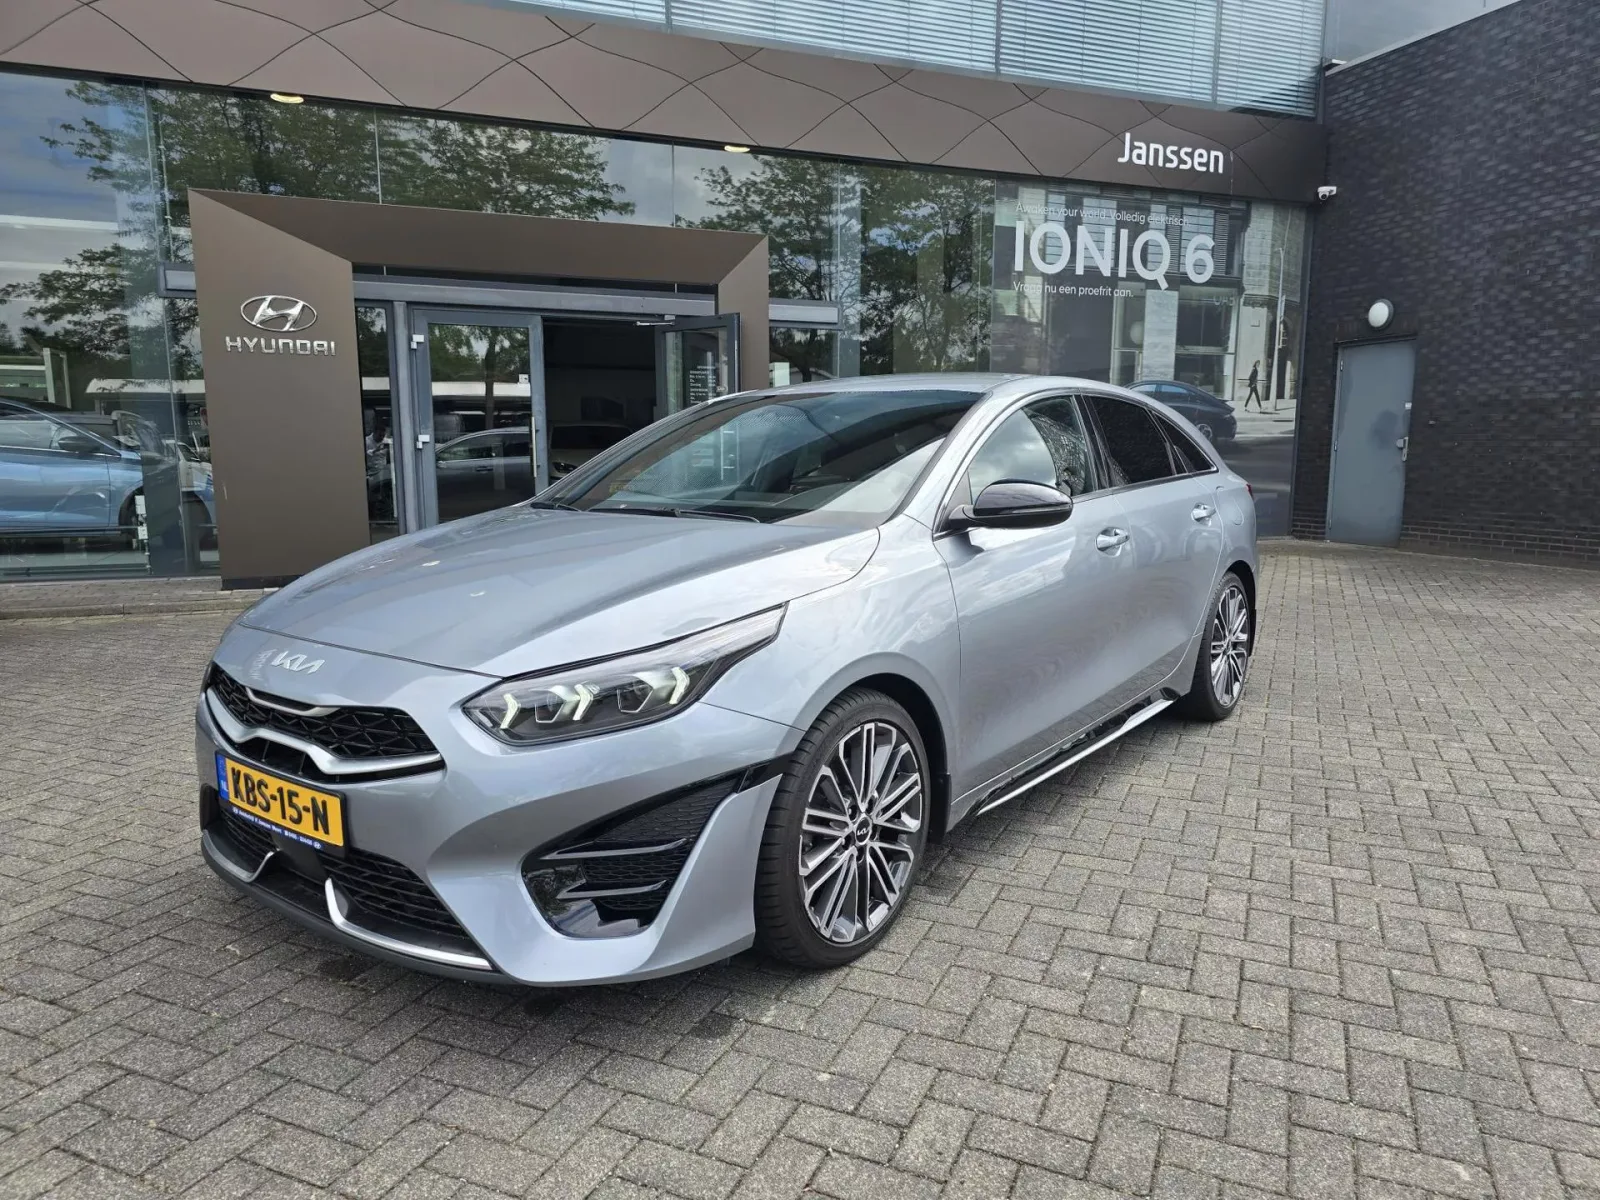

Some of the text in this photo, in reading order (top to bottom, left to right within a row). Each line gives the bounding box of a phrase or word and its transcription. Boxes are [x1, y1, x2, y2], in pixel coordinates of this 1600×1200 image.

[1117, 132, 1224, 174] Janssen
[1016, 202, 1057, 214] Awaken
[1057, 208, 1078, 218] your
[1109, 209, 1146, 224] Volledig
[1014, 220, 1215, 291] IONIQ 6
[1013, 281, 1134, 298] Vraag nu een proefrit aan.
[225, 336, 336, 356] HYUNDAI
[231, 767, 330, 836] KBS-15-N
